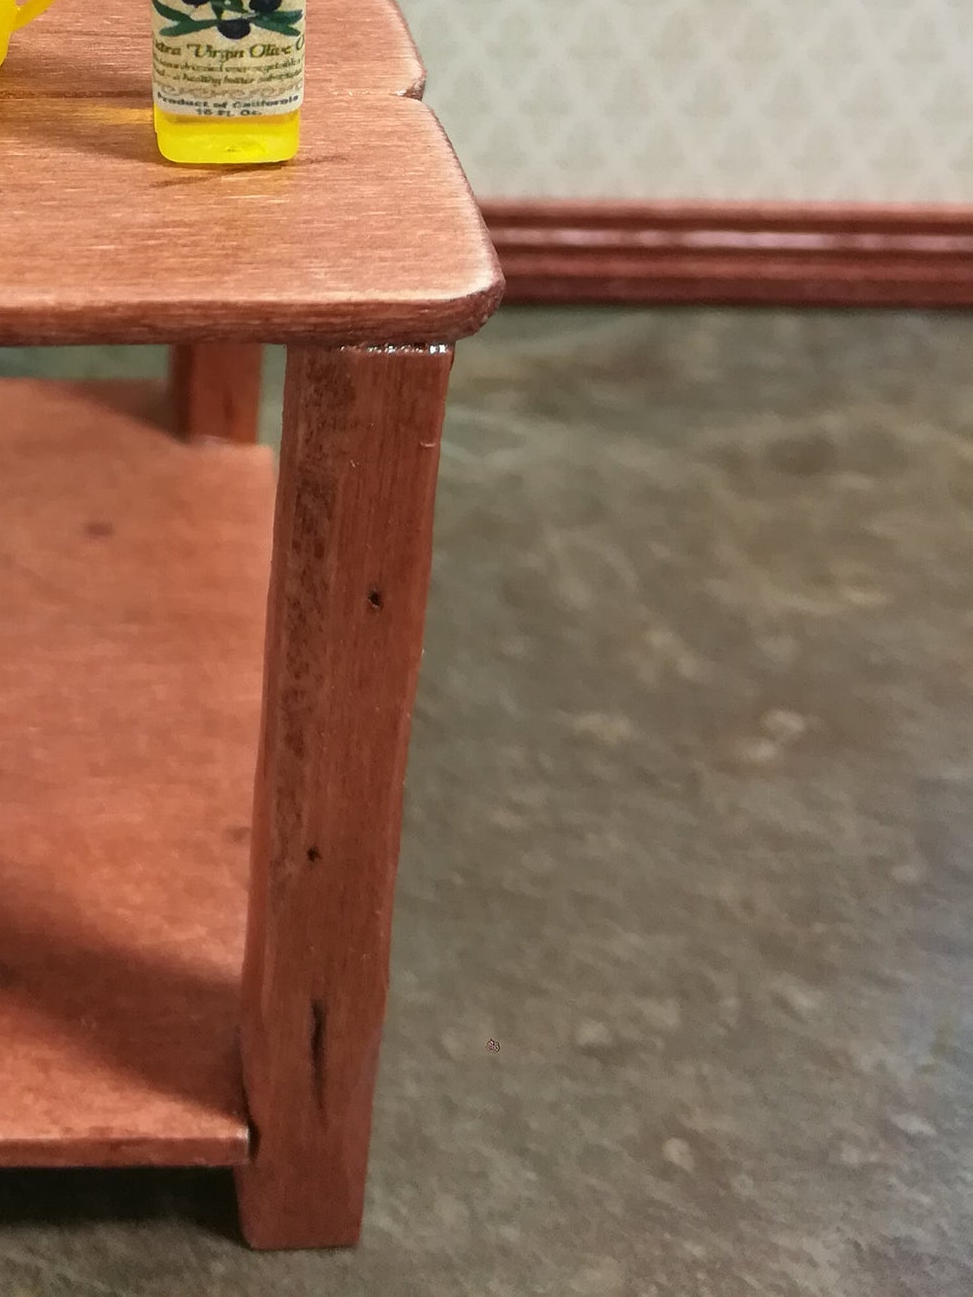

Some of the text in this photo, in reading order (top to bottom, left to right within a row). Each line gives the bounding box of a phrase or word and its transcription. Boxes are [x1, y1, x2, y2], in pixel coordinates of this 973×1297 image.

[186, 43, 244, 63] Virgin
[249, 43, 292, 58] Olive
[157, 91, 210, 107] Product
[232, 94, 299, 108] California
